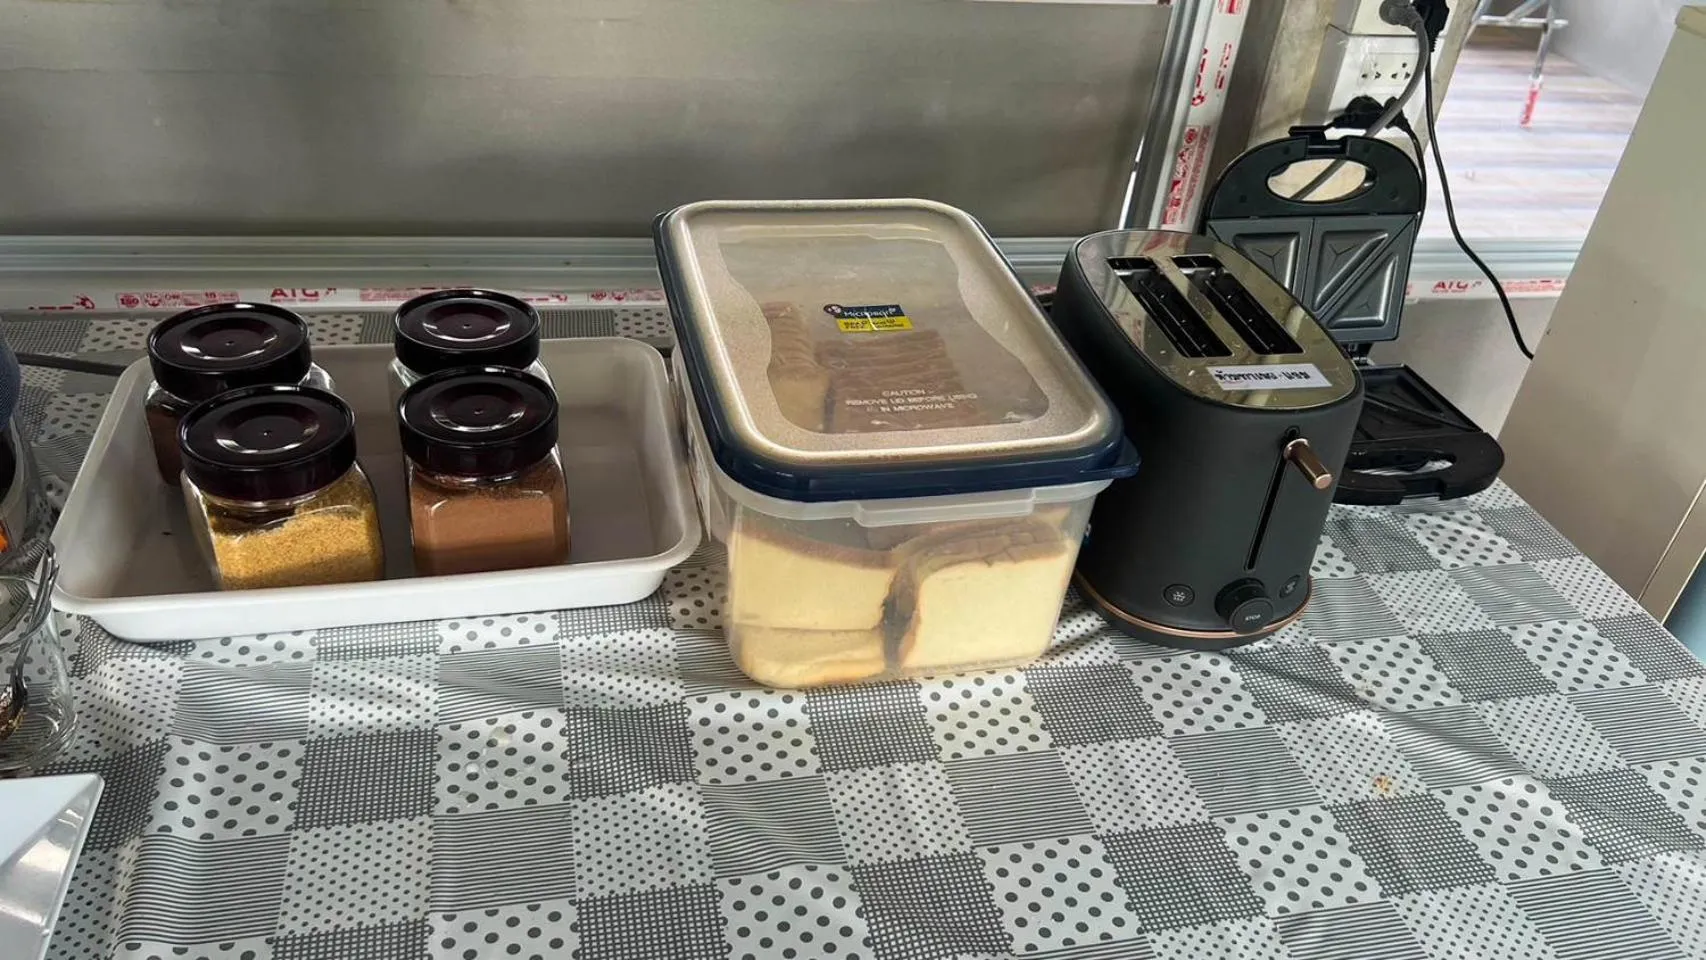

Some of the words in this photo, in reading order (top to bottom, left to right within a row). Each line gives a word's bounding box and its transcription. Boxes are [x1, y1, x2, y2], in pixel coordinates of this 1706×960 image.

[882, 389, 926, 397] CAUTION
[845, 398, 888, 406] REMOVE
[907, 395, 944, 403] BEFORE
[947, 392, 978, 402] USING
[893, 402, 955, 412] MICROWAVE
